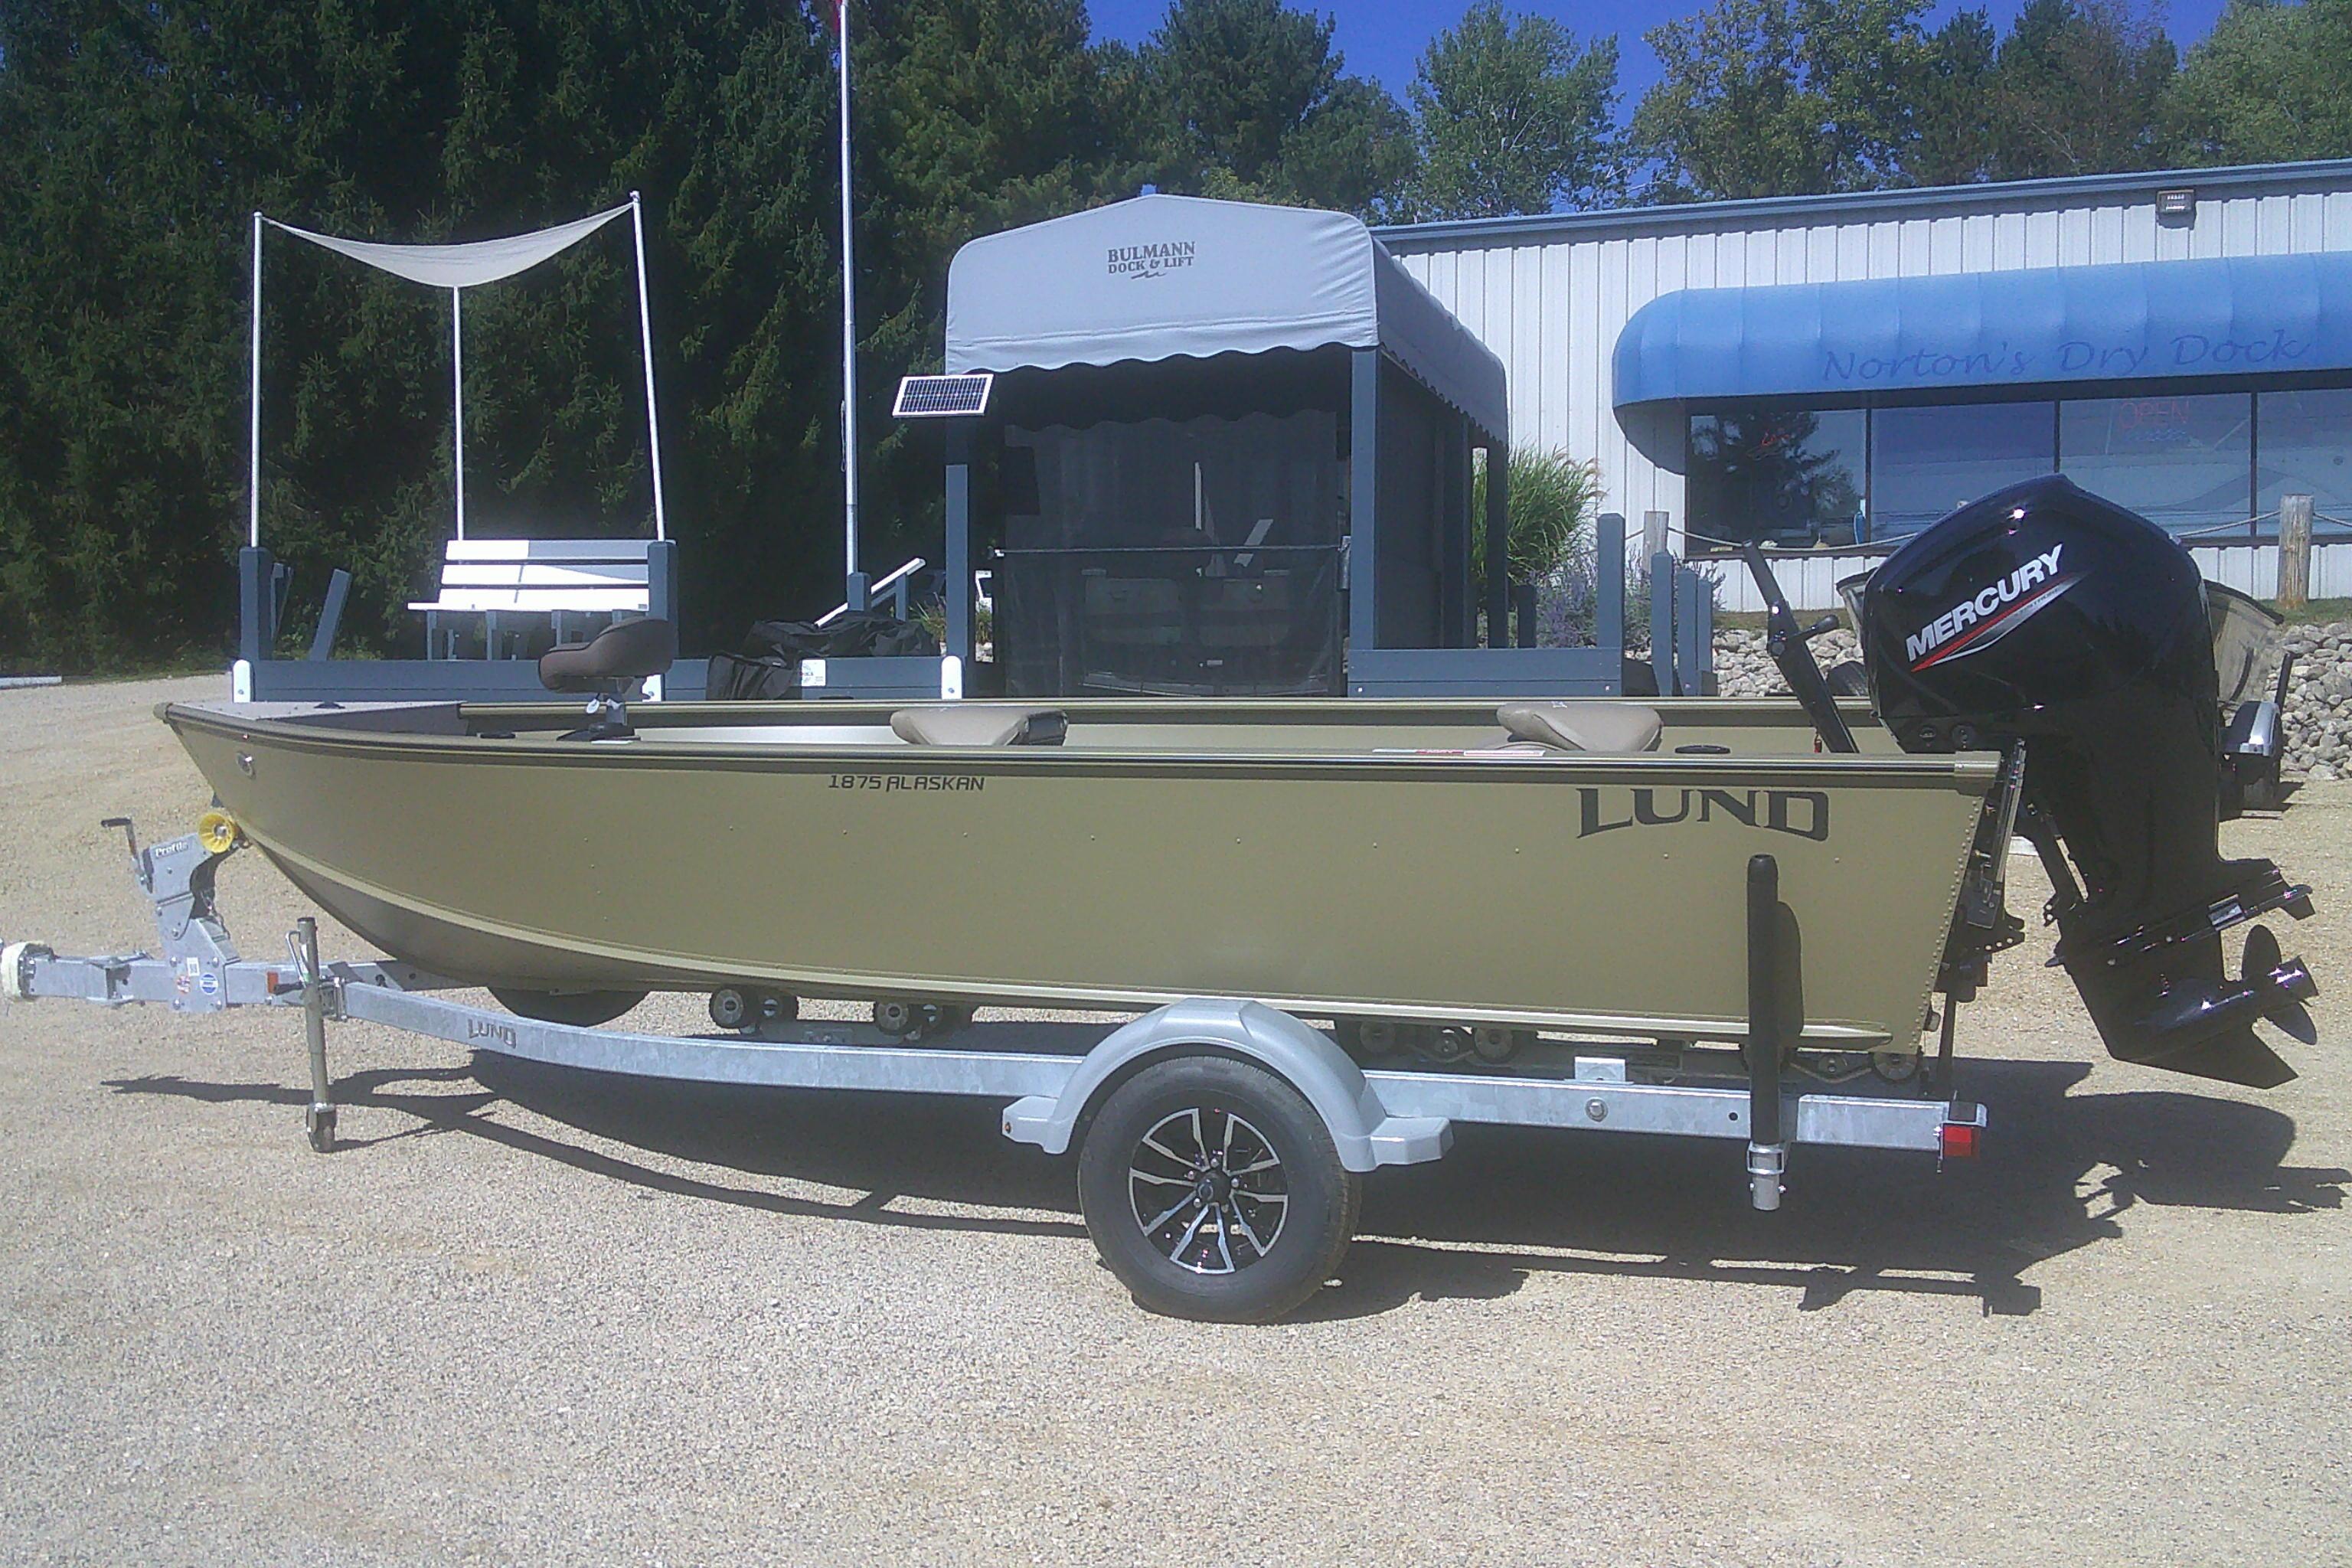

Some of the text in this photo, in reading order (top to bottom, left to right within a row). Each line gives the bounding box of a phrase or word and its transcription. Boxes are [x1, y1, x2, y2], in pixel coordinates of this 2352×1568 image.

[1108, 241, 1195, 263] BULMANN
[1108, 256, 1194, 274] DOCK & LIFT
[1824, 328, 2311, 381] Norton's Dry Dock
[1905, 544, 2063, 662] MERCURY
[828, 774, 985, 792] 1875 ALASKAN
[1575, 787, 1829, 843] LUND
[467, 1019, 517, 1050] LUND
